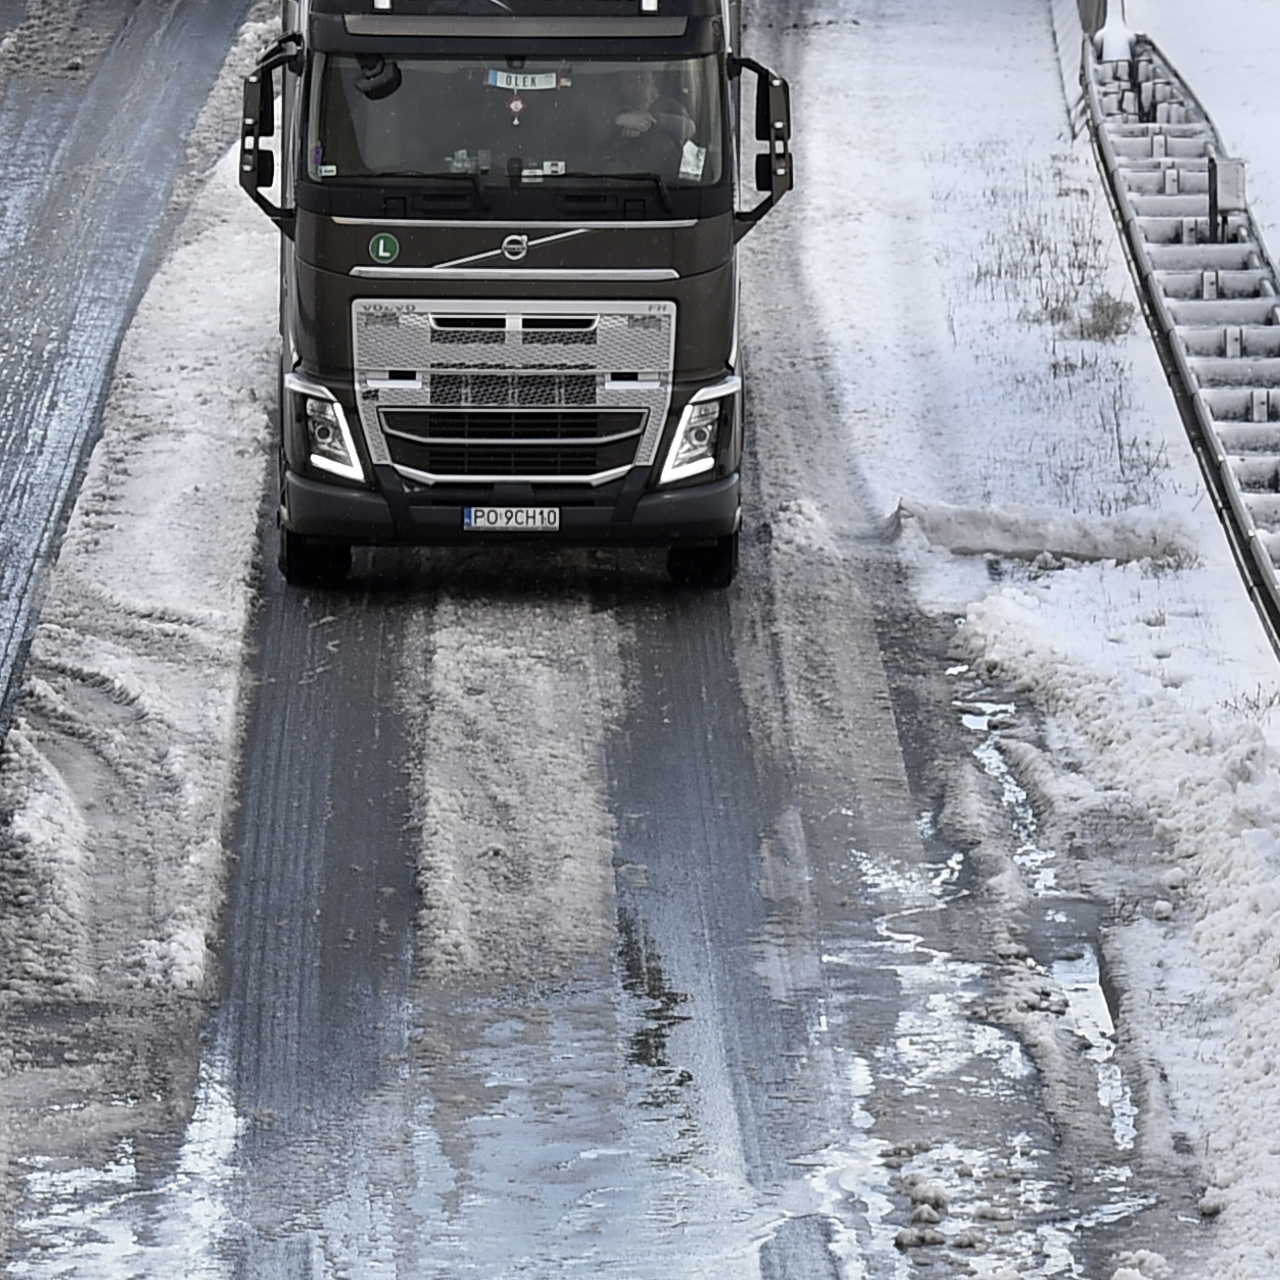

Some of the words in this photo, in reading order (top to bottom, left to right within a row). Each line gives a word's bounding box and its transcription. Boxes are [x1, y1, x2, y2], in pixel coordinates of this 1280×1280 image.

[505, 74, 538, 88] OLEK
[377, 239, 391, 258] L
[361, 304, 417, 313] VOLVO
[473, 509, 499, 526] PO
[504, 509, 558, 526] 9CH10
